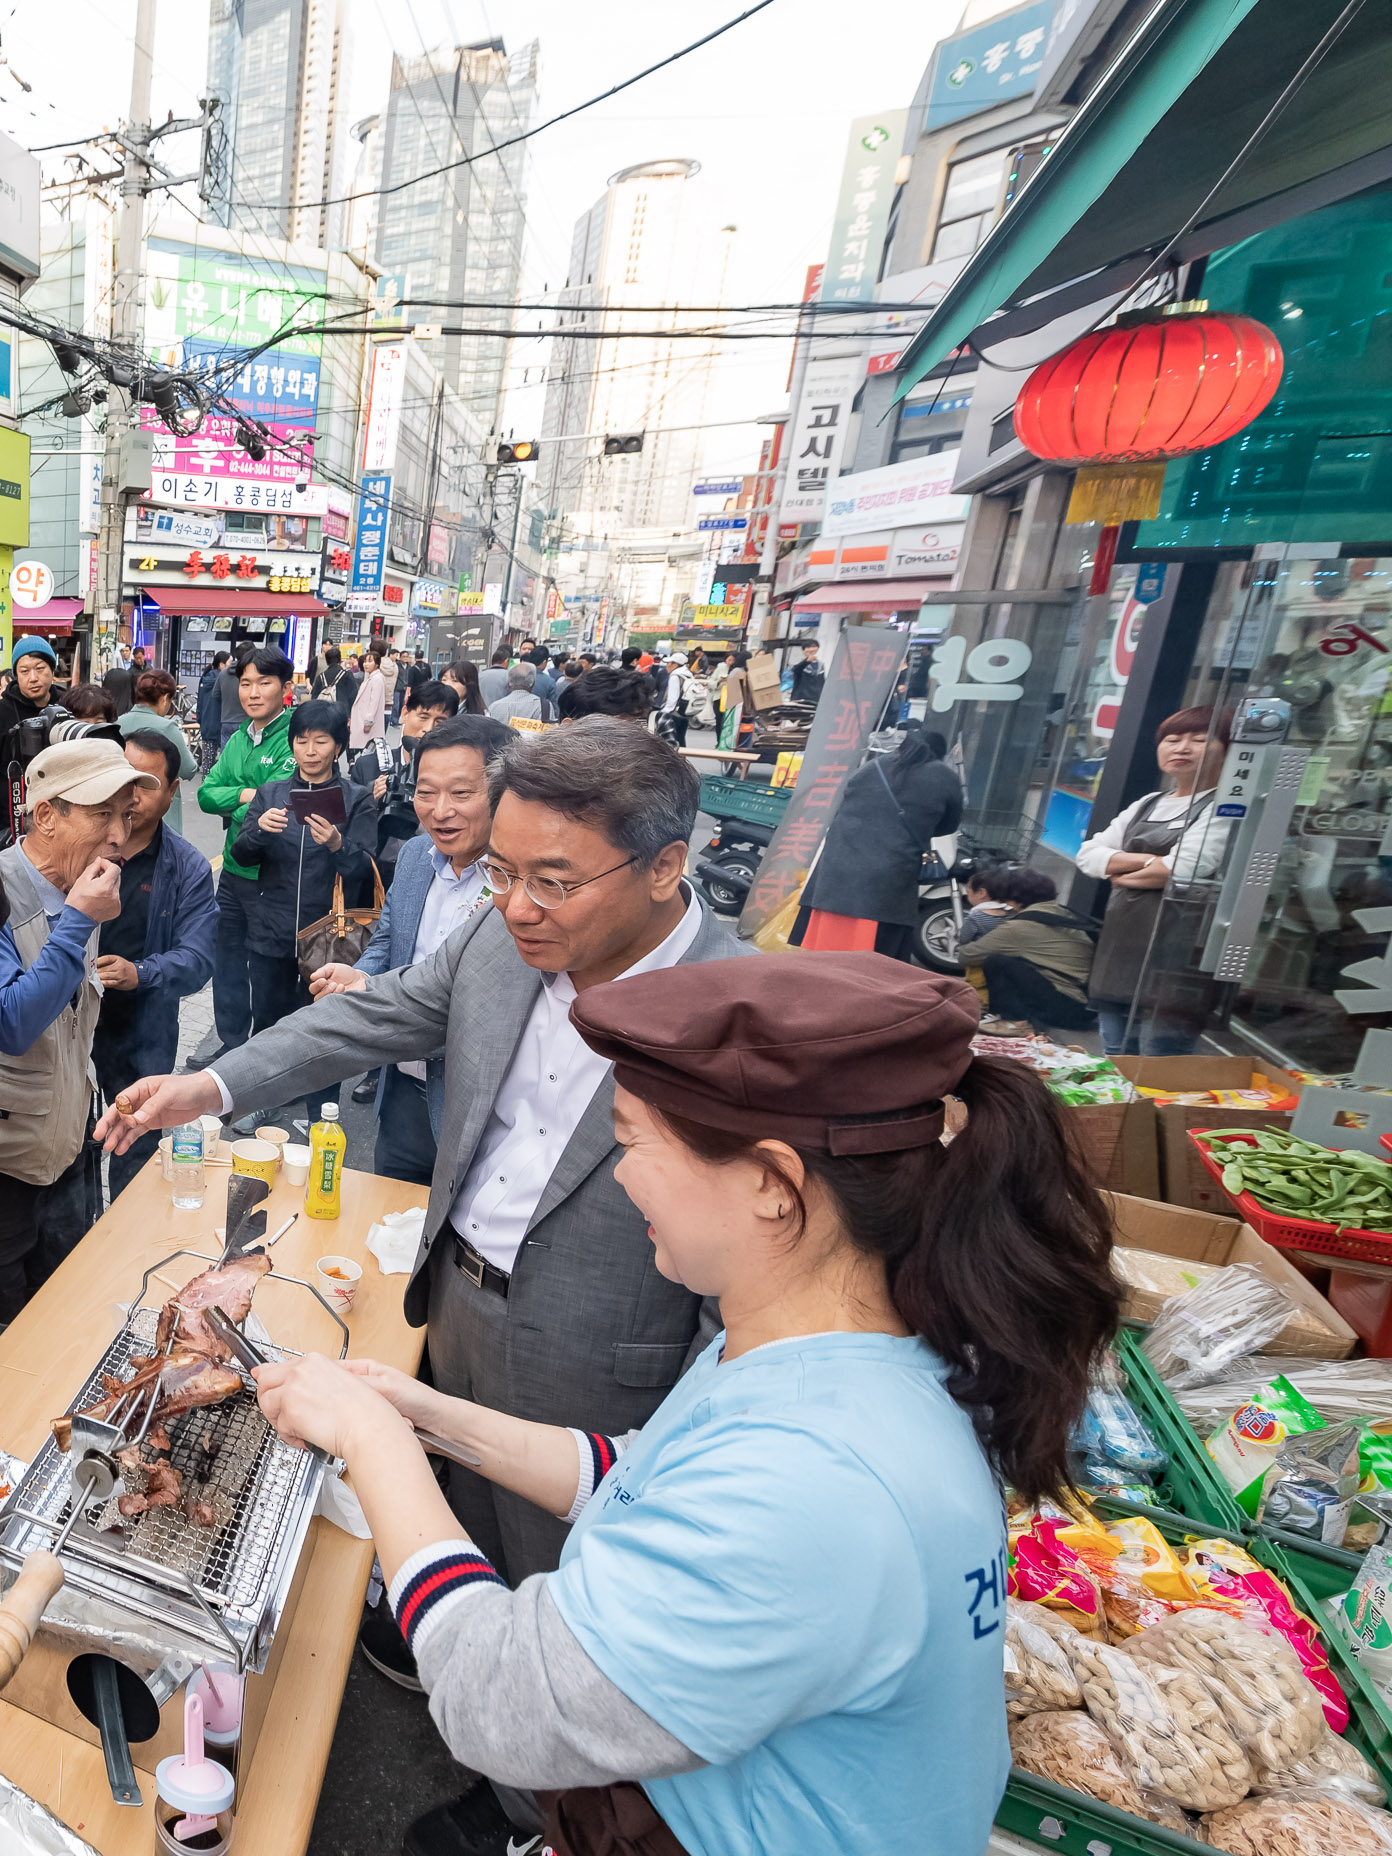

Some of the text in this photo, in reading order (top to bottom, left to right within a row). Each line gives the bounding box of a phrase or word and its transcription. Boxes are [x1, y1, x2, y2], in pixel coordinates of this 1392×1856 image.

[798, 403, 841, 492] 고시텔
[228, 460, 271, 476] 02-444-3044
[162, 478, 293, 509] 이손기 홍콩딤섬
[304, 490, 317, 502] 2F
[173, 521, 214, 540] 성수교회
[138, 556, 159, 571] 2F
[183, 550, 259, 580] 李孫記
[15, 566, 44, 603] 약
[268, 576, 312, 593] 홍콩딤섬
[1227, 751, 1256, 797] 미세요
[12, 781, 21, 806] EOS
[1218, 806, 1245, 816] PUSH
[324, 1151, 335, 1190] 冰糖雪梨
